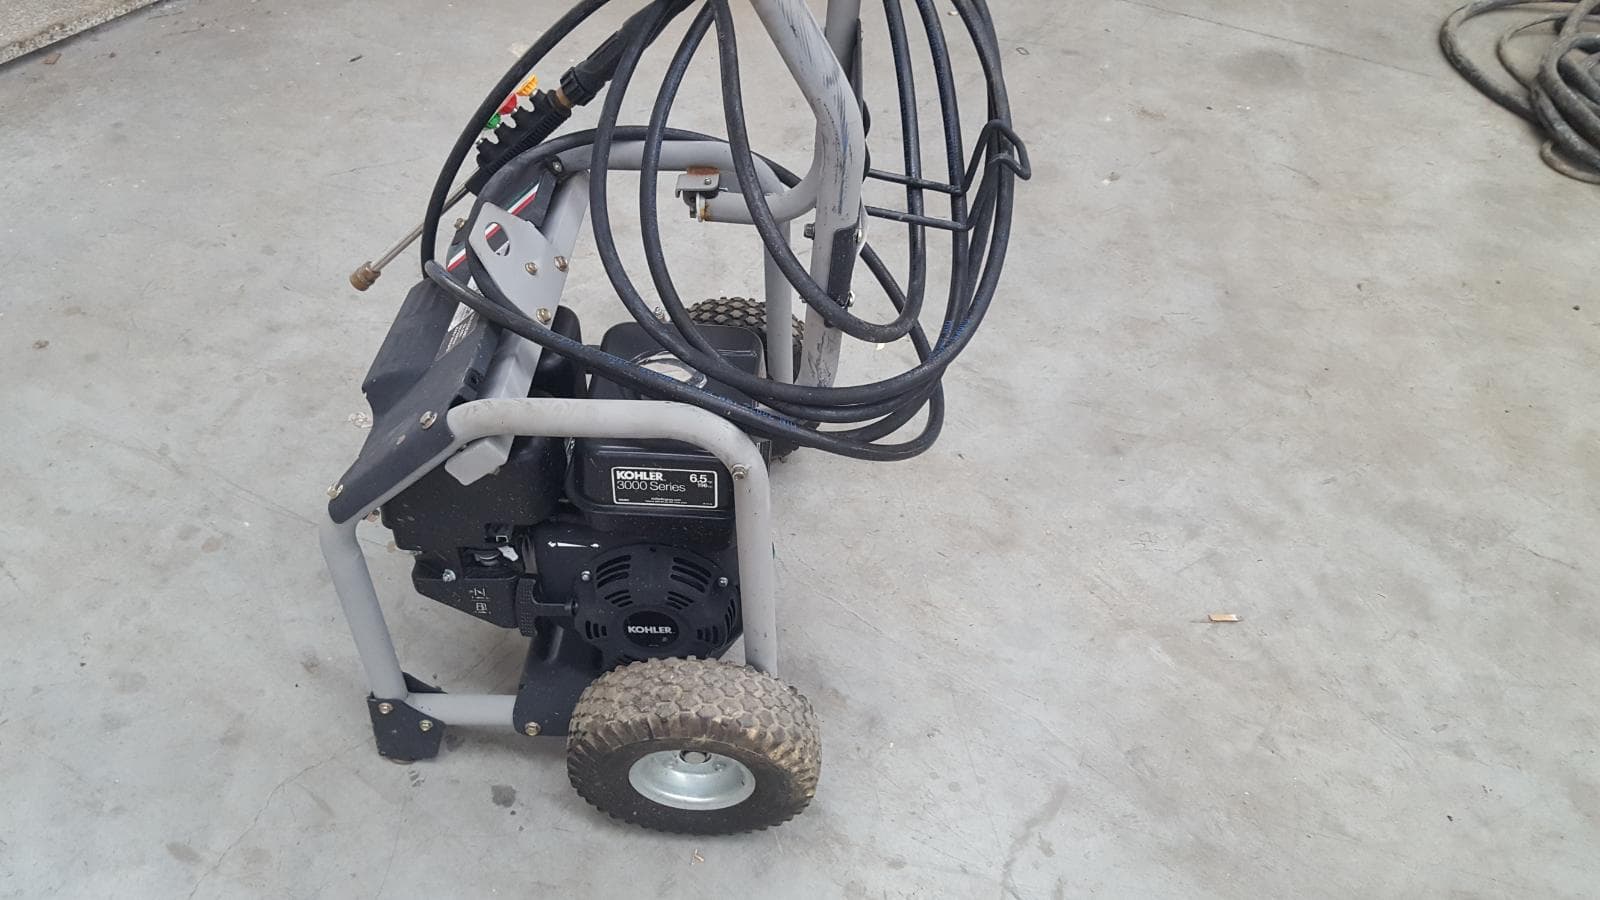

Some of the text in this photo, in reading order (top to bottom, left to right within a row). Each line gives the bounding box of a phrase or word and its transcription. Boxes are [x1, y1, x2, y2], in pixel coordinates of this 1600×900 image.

[616, 470, 663, 481] KOHLER
[690, 473, 707, 483] 6.5
[616, 481, 686, 492] 3000 Series
